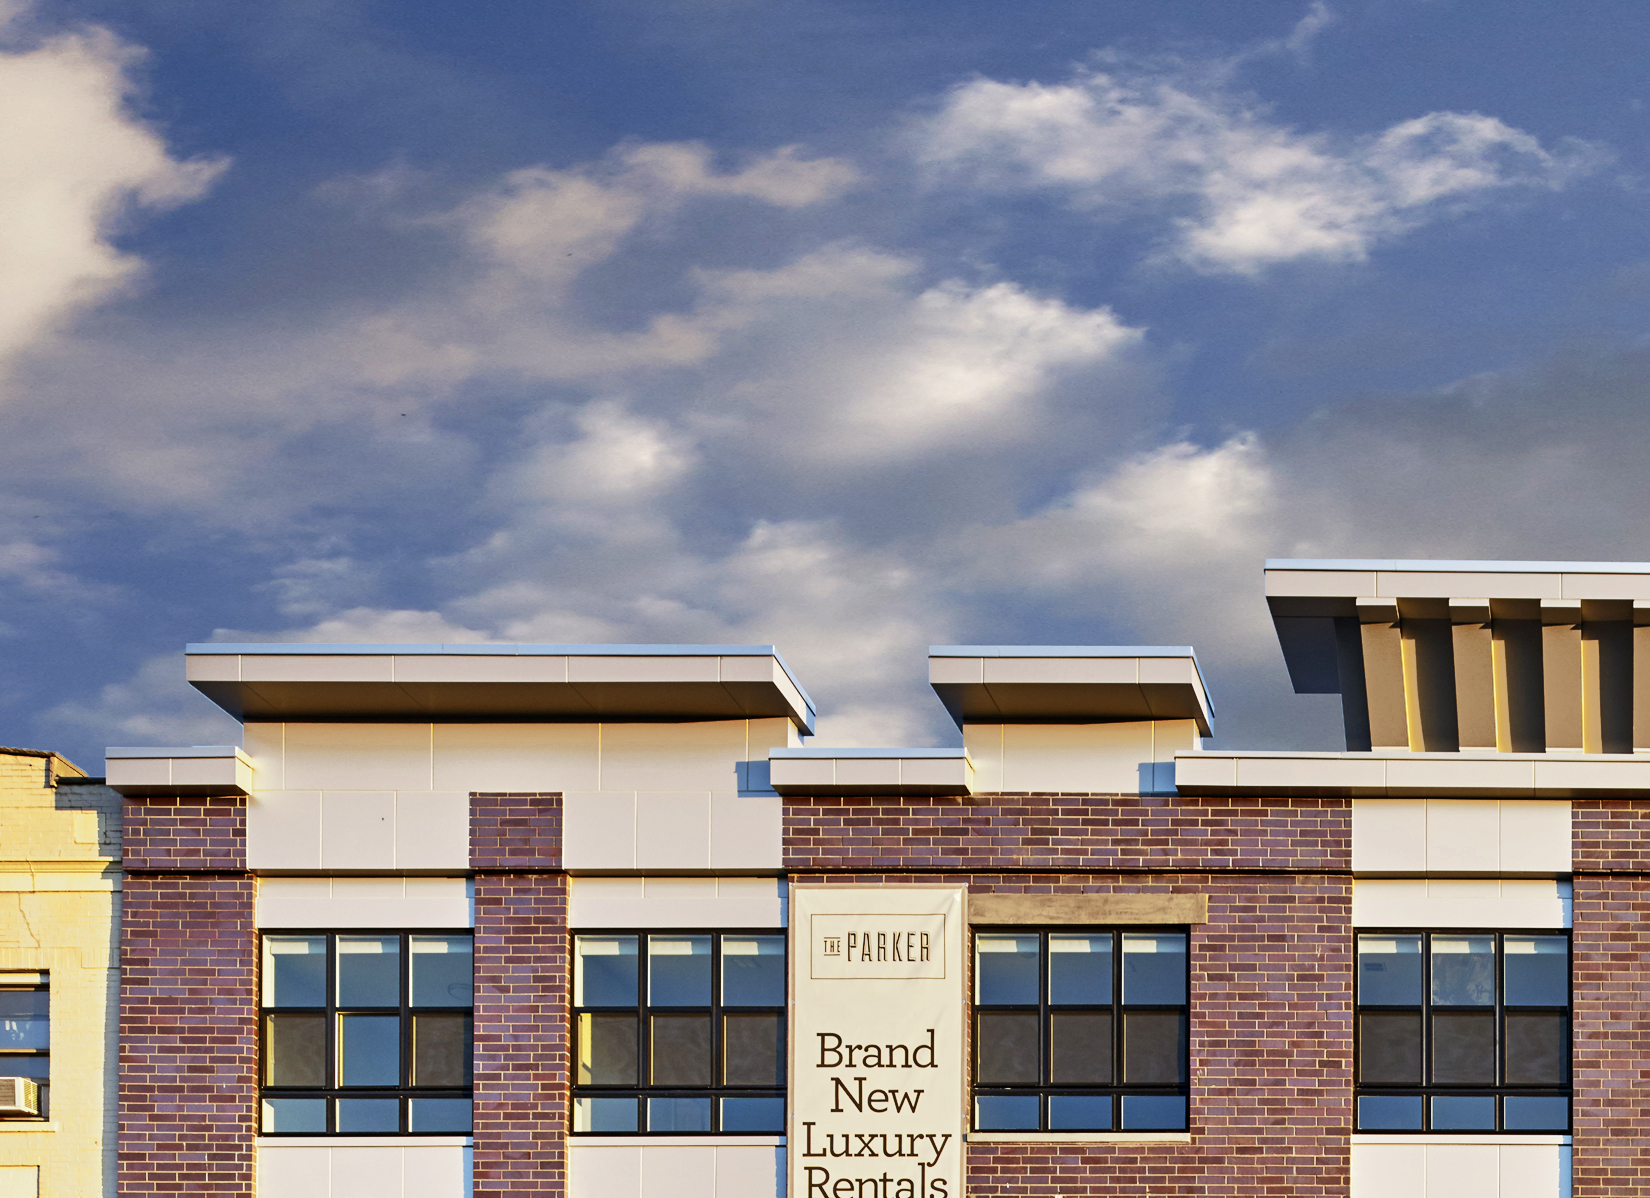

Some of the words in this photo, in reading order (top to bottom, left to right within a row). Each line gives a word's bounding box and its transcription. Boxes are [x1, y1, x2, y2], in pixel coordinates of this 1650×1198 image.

[823, 939, 841, 953] THE
[847, 931, 931, 962] PARKER
[816, 1029, 938, 1068] Brand
[830, 1077, 924, 1113] New
[802, 1121, 952, 1167] Luxury
